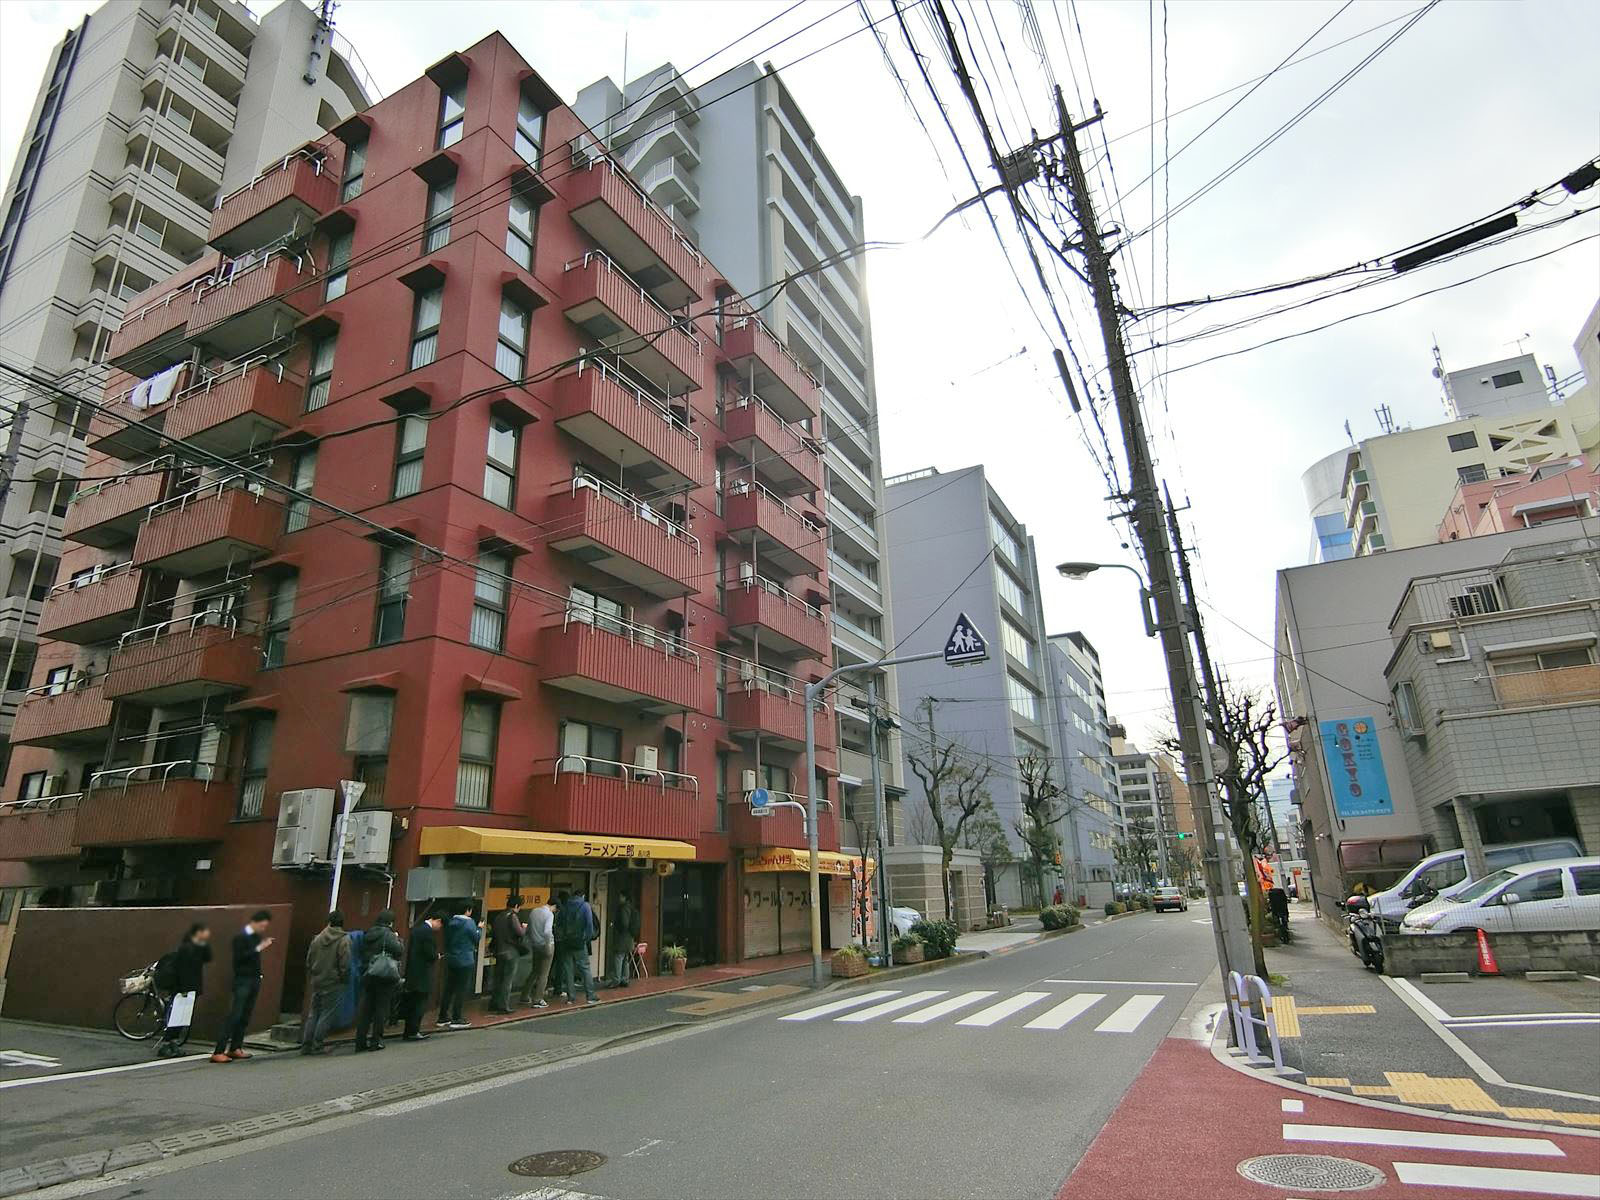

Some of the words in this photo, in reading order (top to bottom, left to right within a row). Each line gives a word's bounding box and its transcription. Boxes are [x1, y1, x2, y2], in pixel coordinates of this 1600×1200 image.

[583, 843, 635, 857] ラーメン二郎
